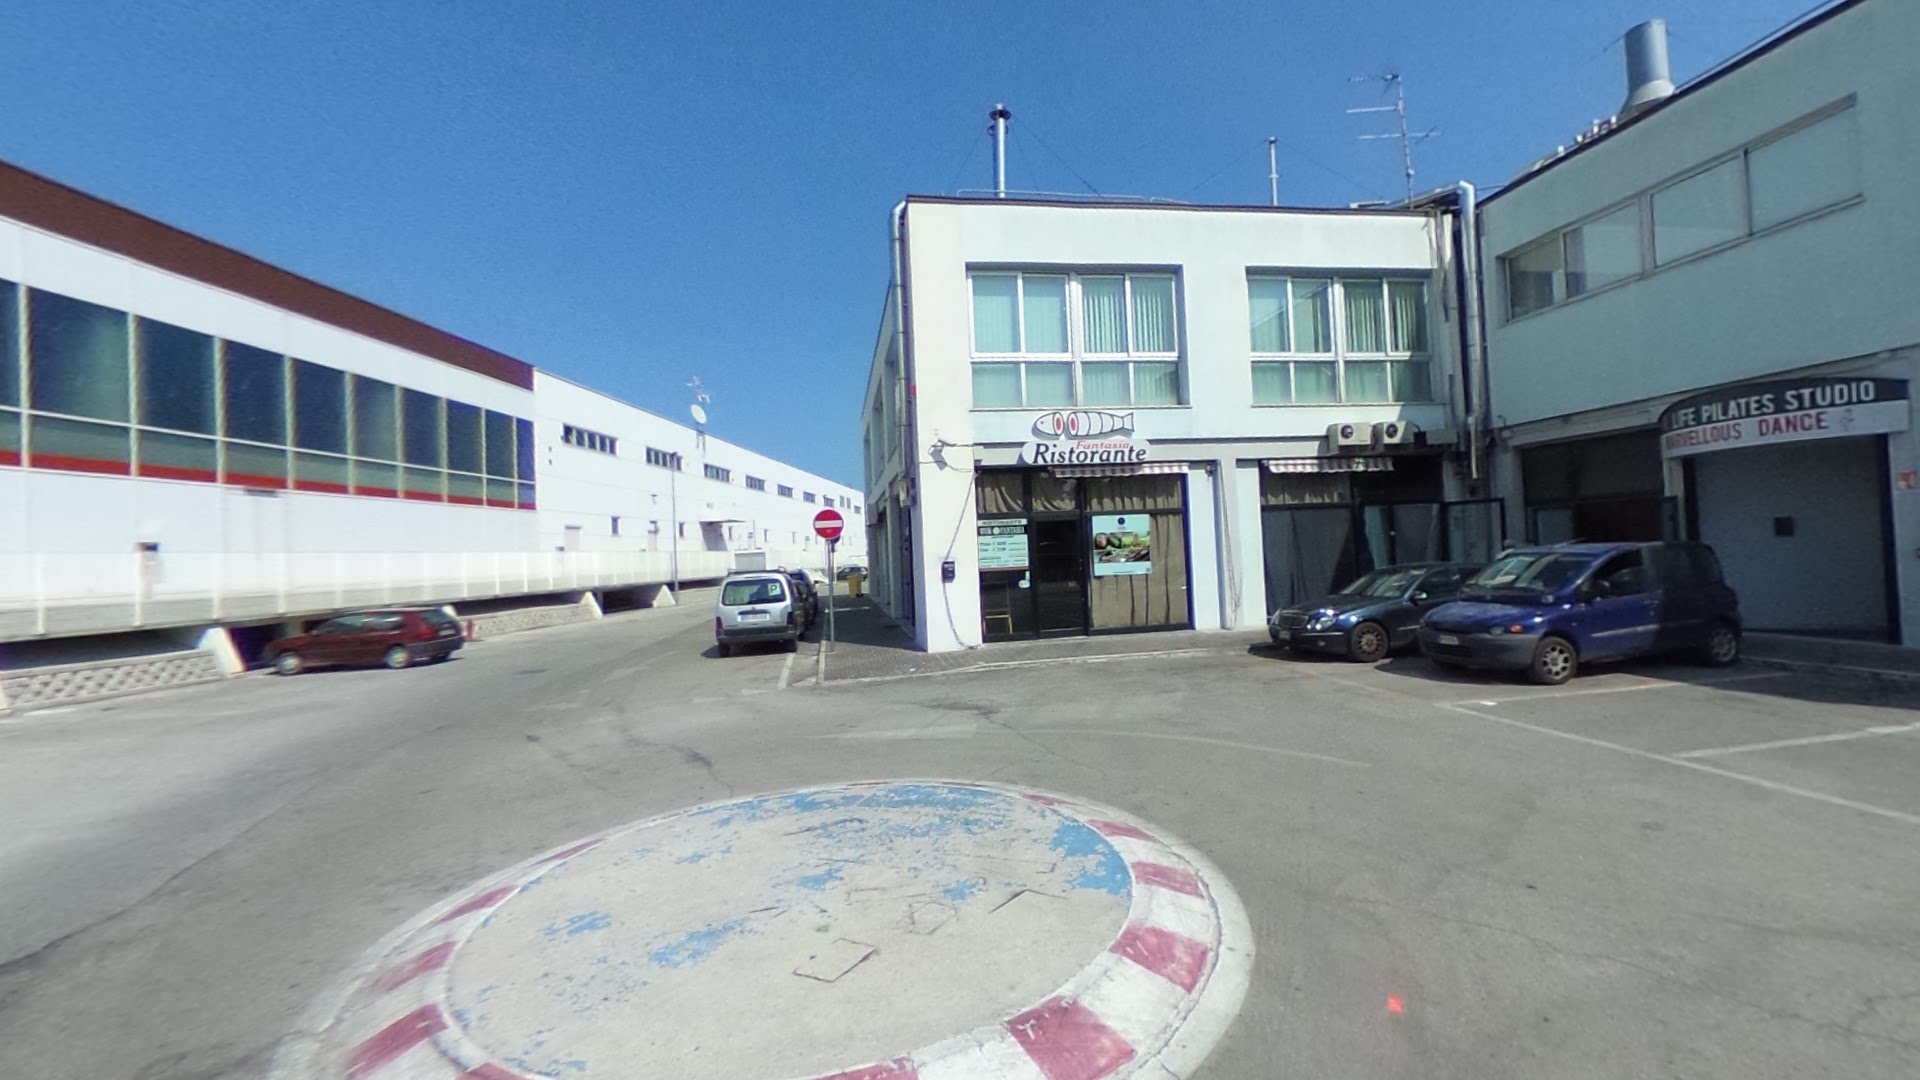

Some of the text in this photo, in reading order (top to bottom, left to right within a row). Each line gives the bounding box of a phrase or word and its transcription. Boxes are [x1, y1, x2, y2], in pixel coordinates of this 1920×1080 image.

[1671, 380, 1876, 429] LIFE PILATES STUDIO
[1758, 411, 1829, 437] DANCE
[1032, 443, 1147, 464] Ristorante
[1075, 440, 1130, 450] Fantasia
[770, 584, 777, 593] P
